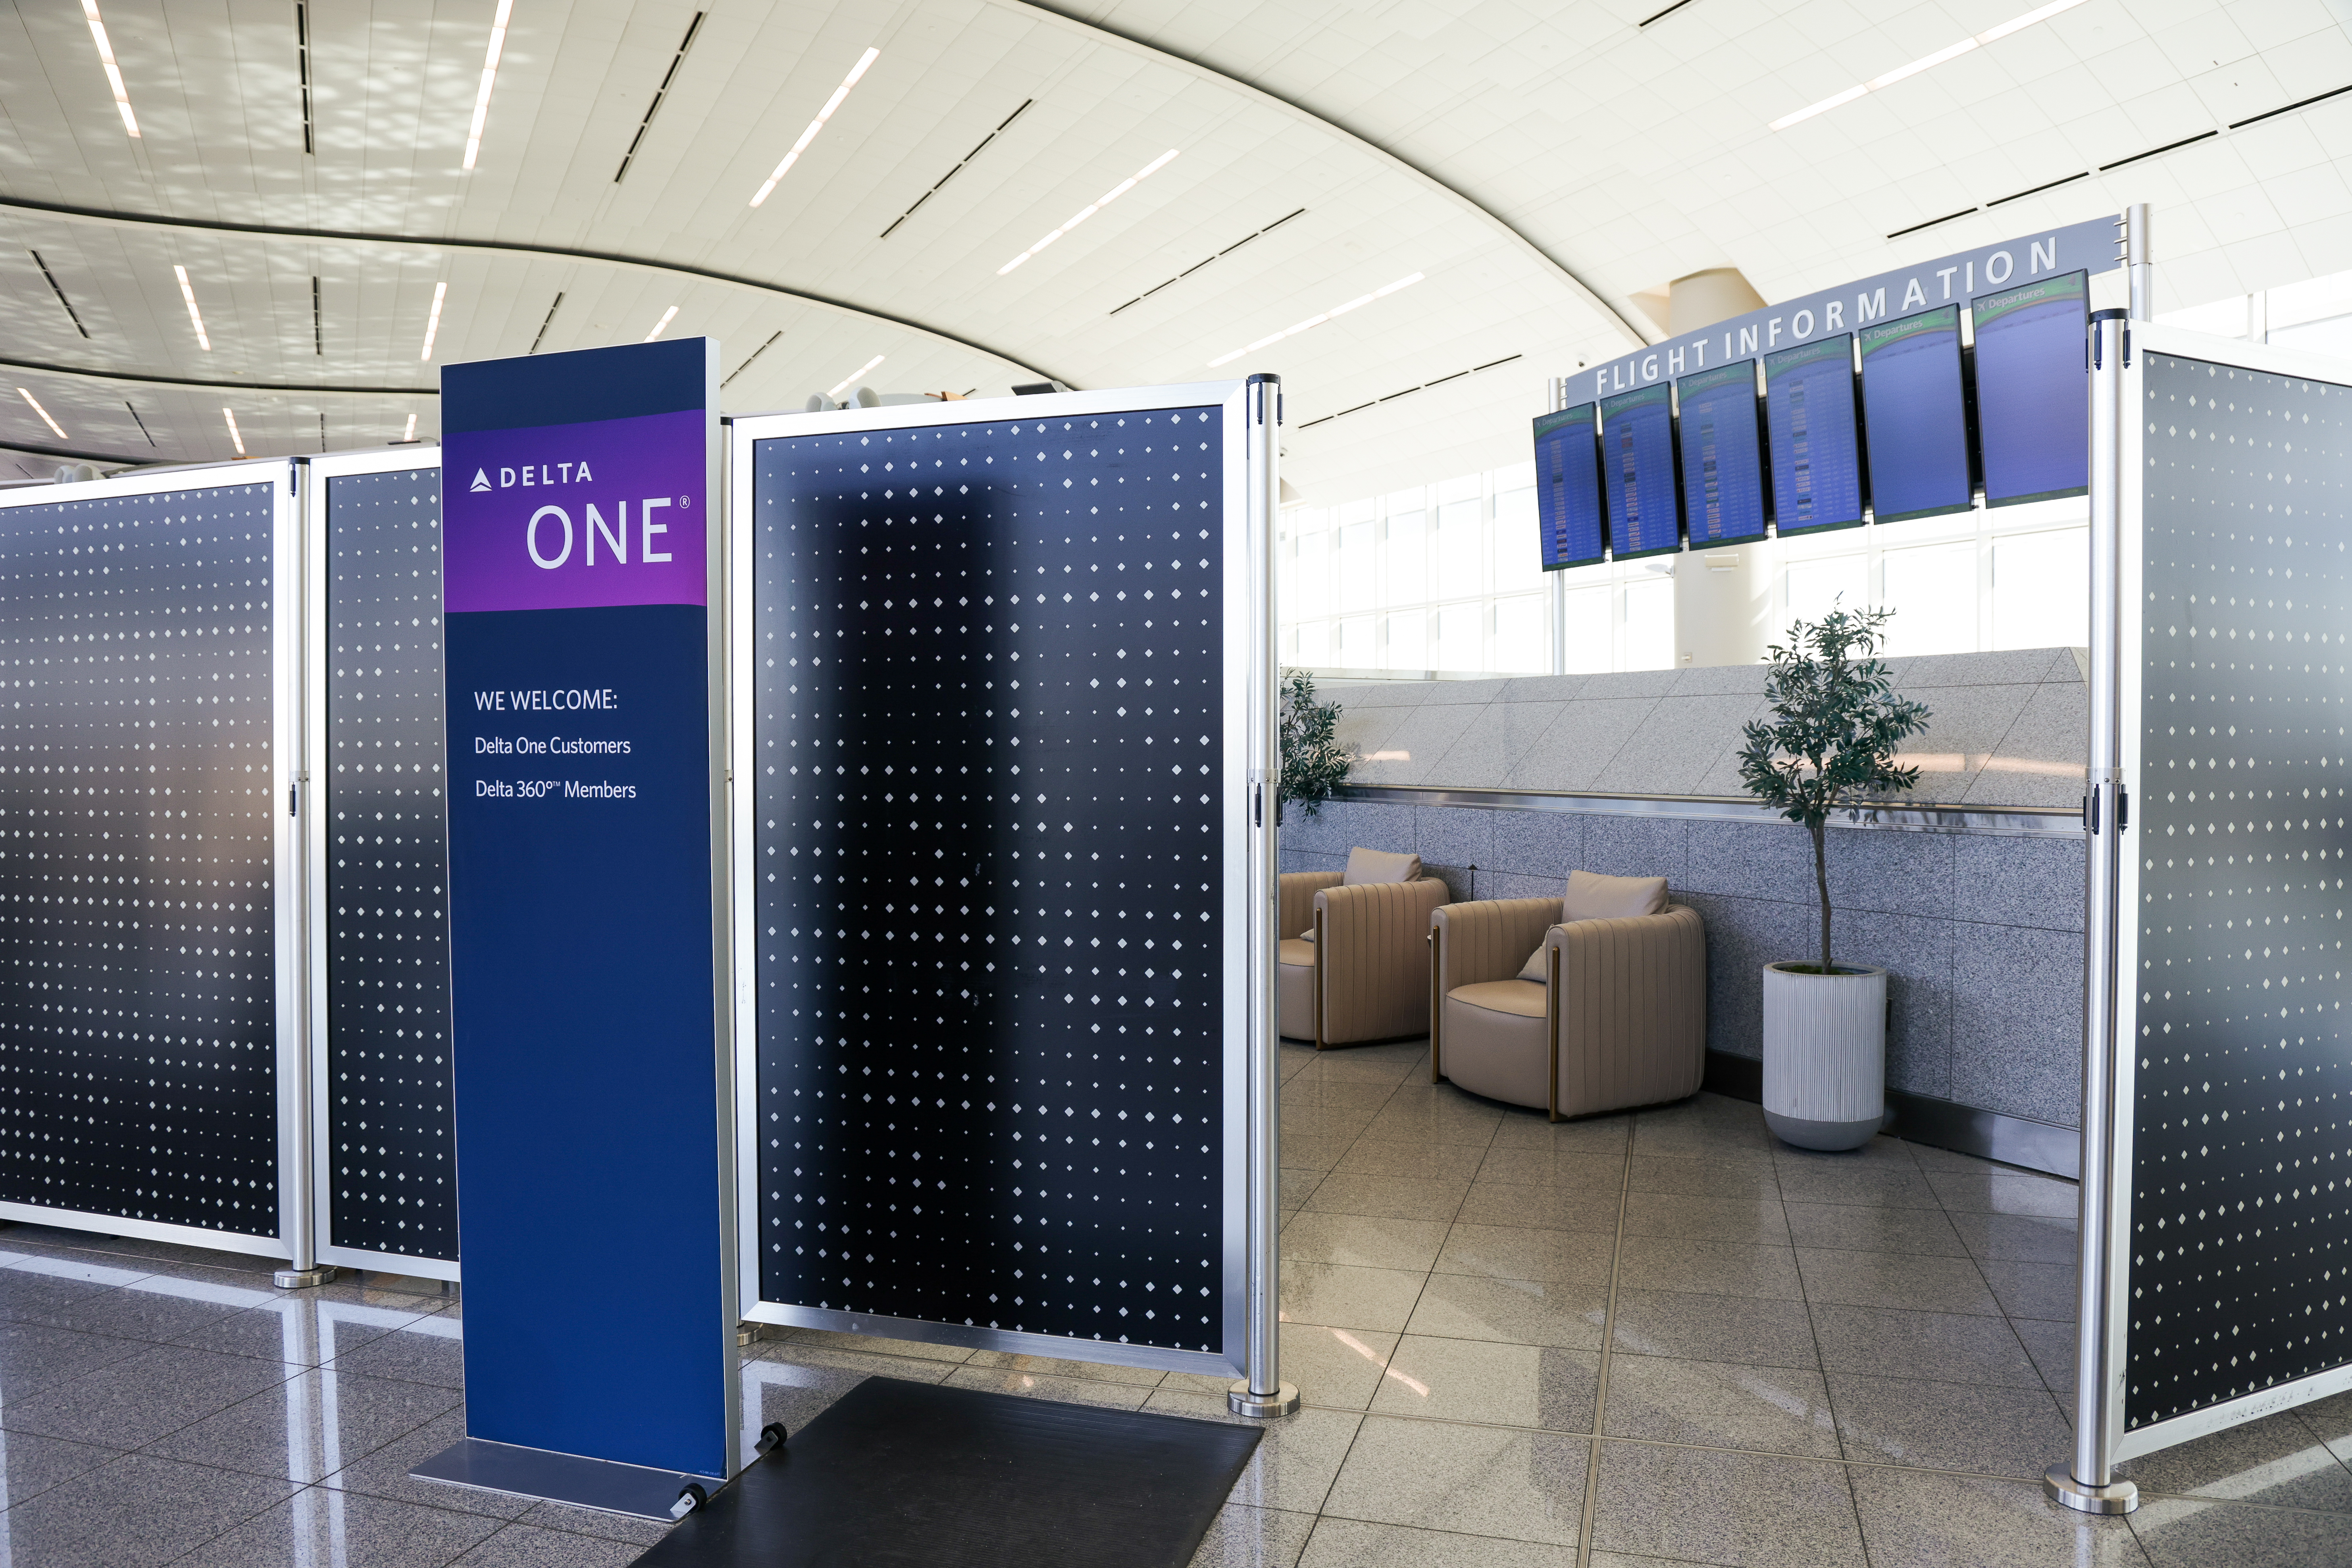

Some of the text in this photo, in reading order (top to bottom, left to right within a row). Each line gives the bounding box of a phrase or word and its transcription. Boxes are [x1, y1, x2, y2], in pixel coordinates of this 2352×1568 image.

[1988, 287, 2045, 309] Departures
[1597, 237, 2057, 395] FLIGHT INFORMATION
[1874, 319, 1923, 339] Departures
[1777, 347, 1821, 364] Departures
[1689, 372, 1727, 387] Departures
[1611, 393, 1645, 408] Departures
[501, 462, 592, 487] DELTA
[474, 689, 617, 710] WE WELCOME:
[475, 737, 630, 754] Delta One Customers
[476, 780, 513, 797] Delta
[565, 781, 636, 798] Members
